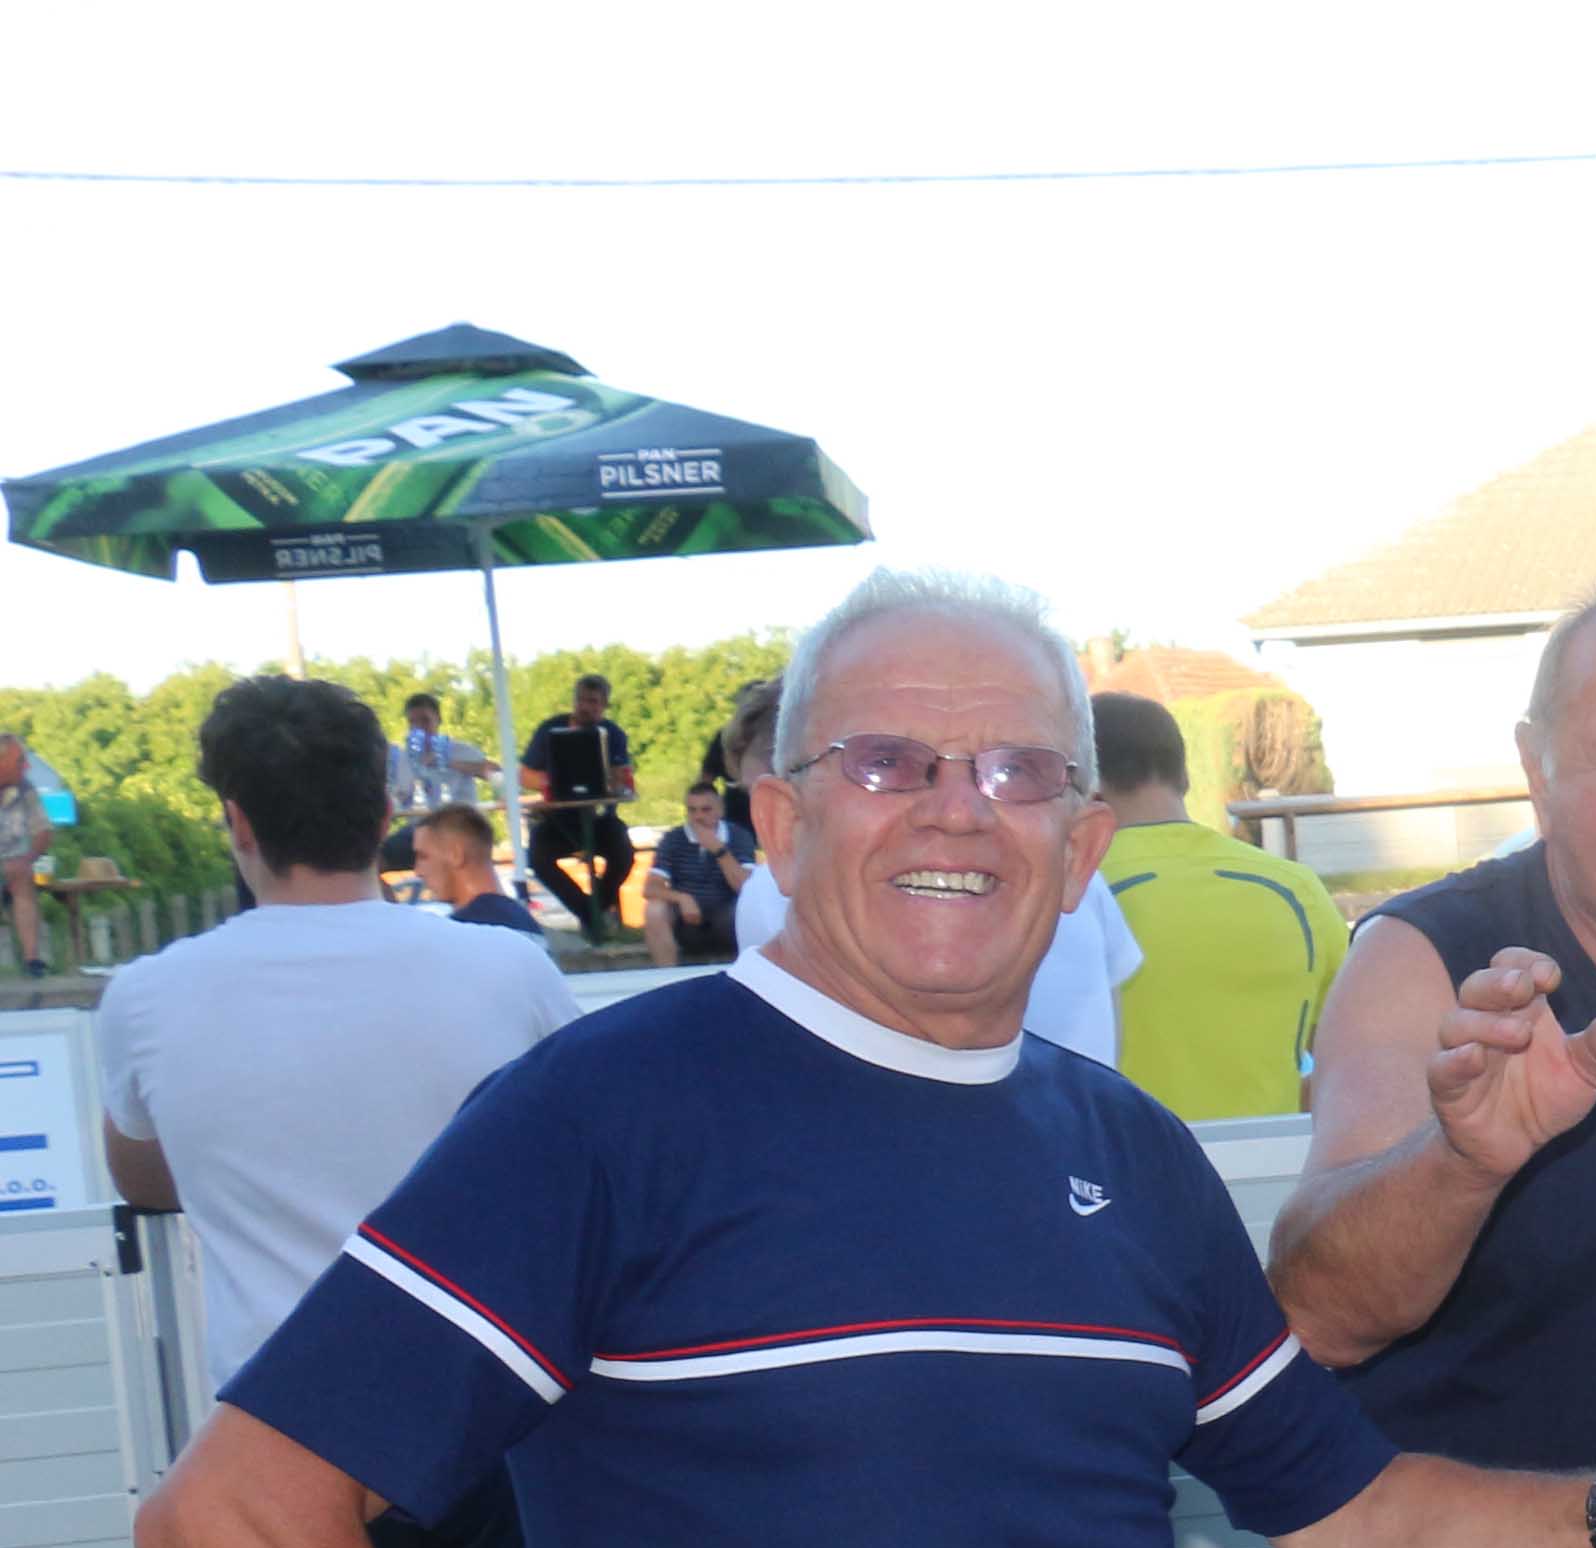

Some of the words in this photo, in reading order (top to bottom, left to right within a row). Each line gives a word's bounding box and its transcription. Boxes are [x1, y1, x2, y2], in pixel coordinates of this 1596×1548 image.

[296, 386, 577, 466] PAN
[637, 447, 677, 461] PAN
[600, 460, 720, 487] PILSNER
